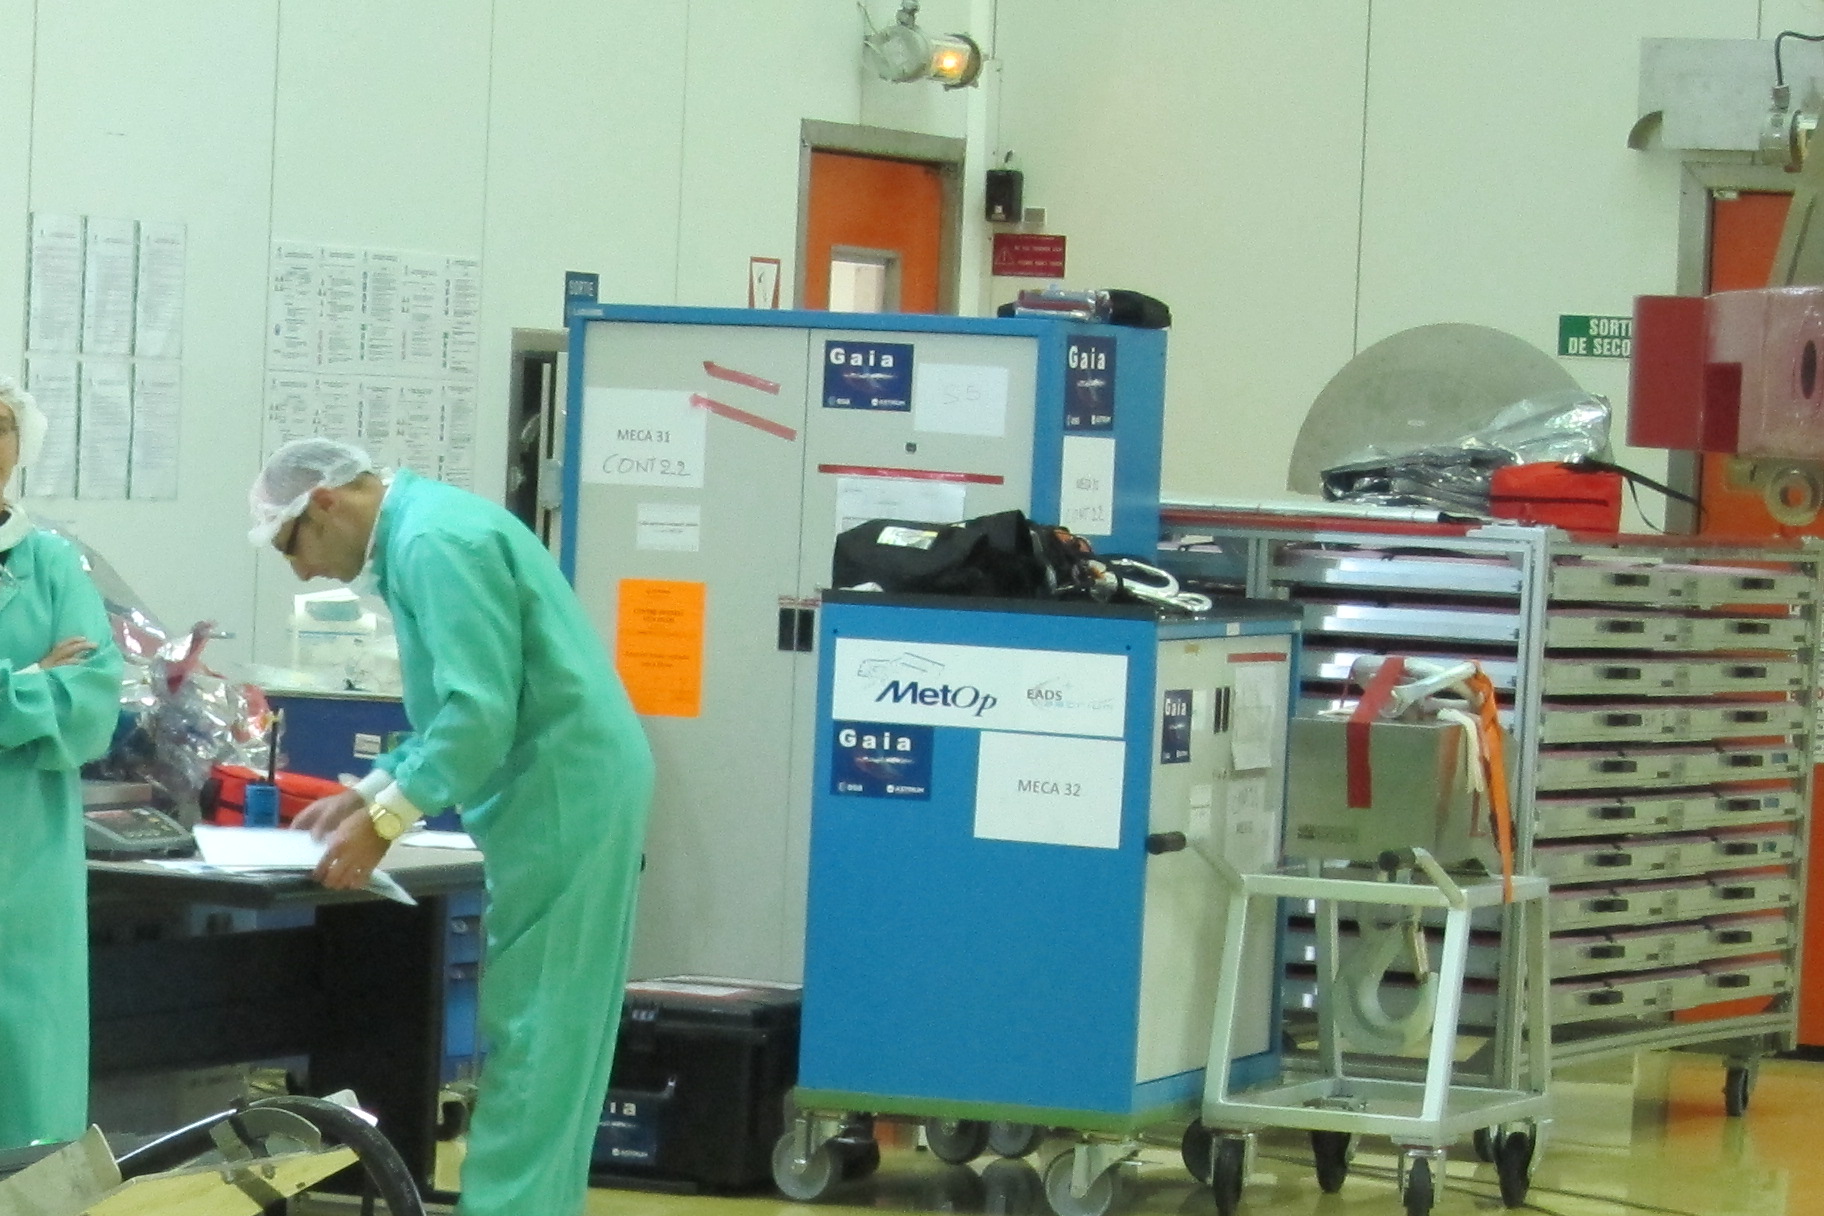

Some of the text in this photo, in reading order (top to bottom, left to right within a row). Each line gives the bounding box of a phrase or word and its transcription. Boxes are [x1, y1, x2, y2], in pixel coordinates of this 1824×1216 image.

[568, 279, 594, 297] SORTIE
[1588, 318, 1633, 337] SORTI
[1567, 337, 1632, 357] DE SECO
[829, 347, 895, 368] Gaia
[1067, 345, 1107, 370] Gaia
[616, 428, 671, 444] MECA 31
[602, 453, 657, 475] CONT
[875, 679, 998, 718] MetOp
[1026, 688, 1063, 702] EADS
[1164, 698, 1188, 718] Gaia
[838, 728, 912, 752] Gaia
[1017, 779, 1082, 797] MECA 32
[610, 1102, 636, 1117] ia
